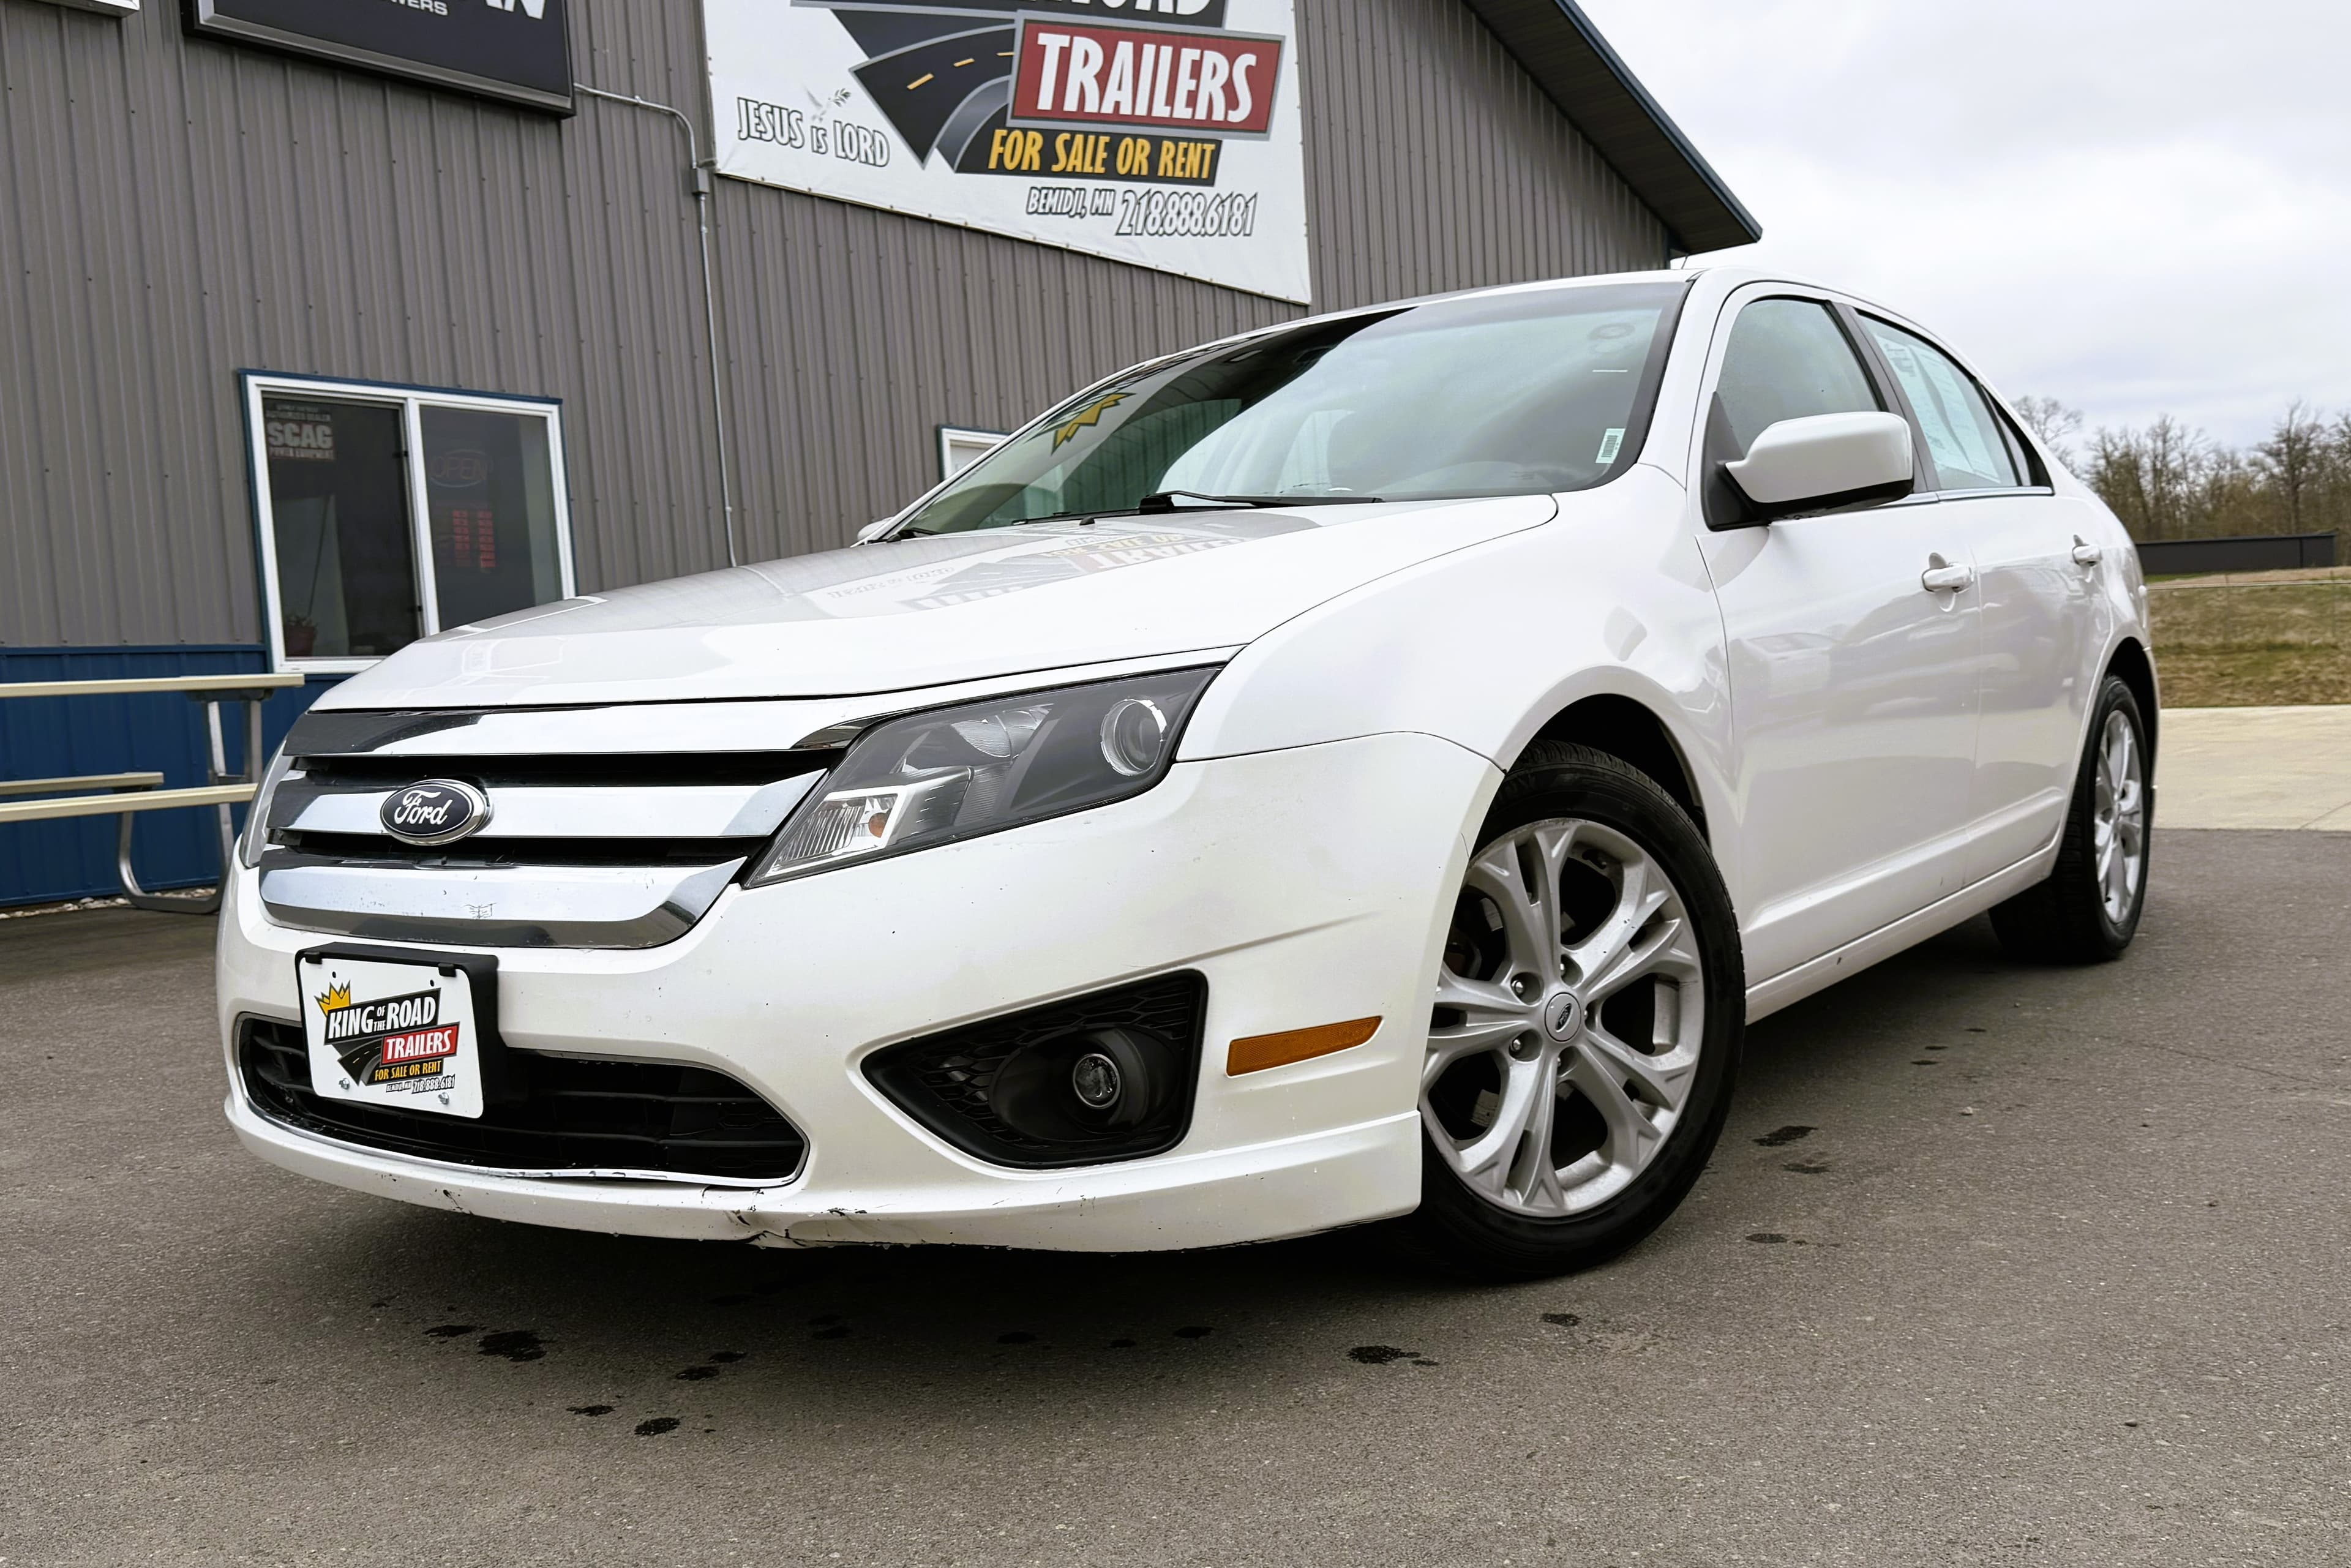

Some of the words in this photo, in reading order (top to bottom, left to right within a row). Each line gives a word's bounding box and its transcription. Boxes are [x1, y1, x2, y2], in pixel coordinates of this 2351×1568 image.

[391, 0, 448, 15] ERS
[1037, 32, 1257, 124] TRAILERS
[737, 97, 805, 149] JESUS
[811, 126, 828, 154] IS
[833, 120, 890, 167] LORD
[988, 129, 1043, 171] FOR
[1051, 133, 1110, 173] SALE
[1116, 137, 1151, 176] OR
[1157, 140, 1215, 179] RENT
[1026, 187, 1087, 219] BEMIDJI,
[1090, 189, 1116, 216] MN
[1114, 188, 1258, 237] 218.888.6181
[268, 422, 333, 448] SCAG
[394, 790, 452, 825] Ford
[328, 1006, 374, 1039] KING
[373, 1019, 386, 1032] THE
[377, 1005, 386, 1017] OF
[386, 996, 436, 1030] ROAD
[386, 1030, 452, 1060] TRAILERS
[375, 1068, 389, 1081] FOR
[391, 1065, 407, 1079] SALE
[410, 1063, 419, 1076] OR
[422, 1060, 441, 1074] RENT
[411, 1074, 456, 1094] 218.888.6181
